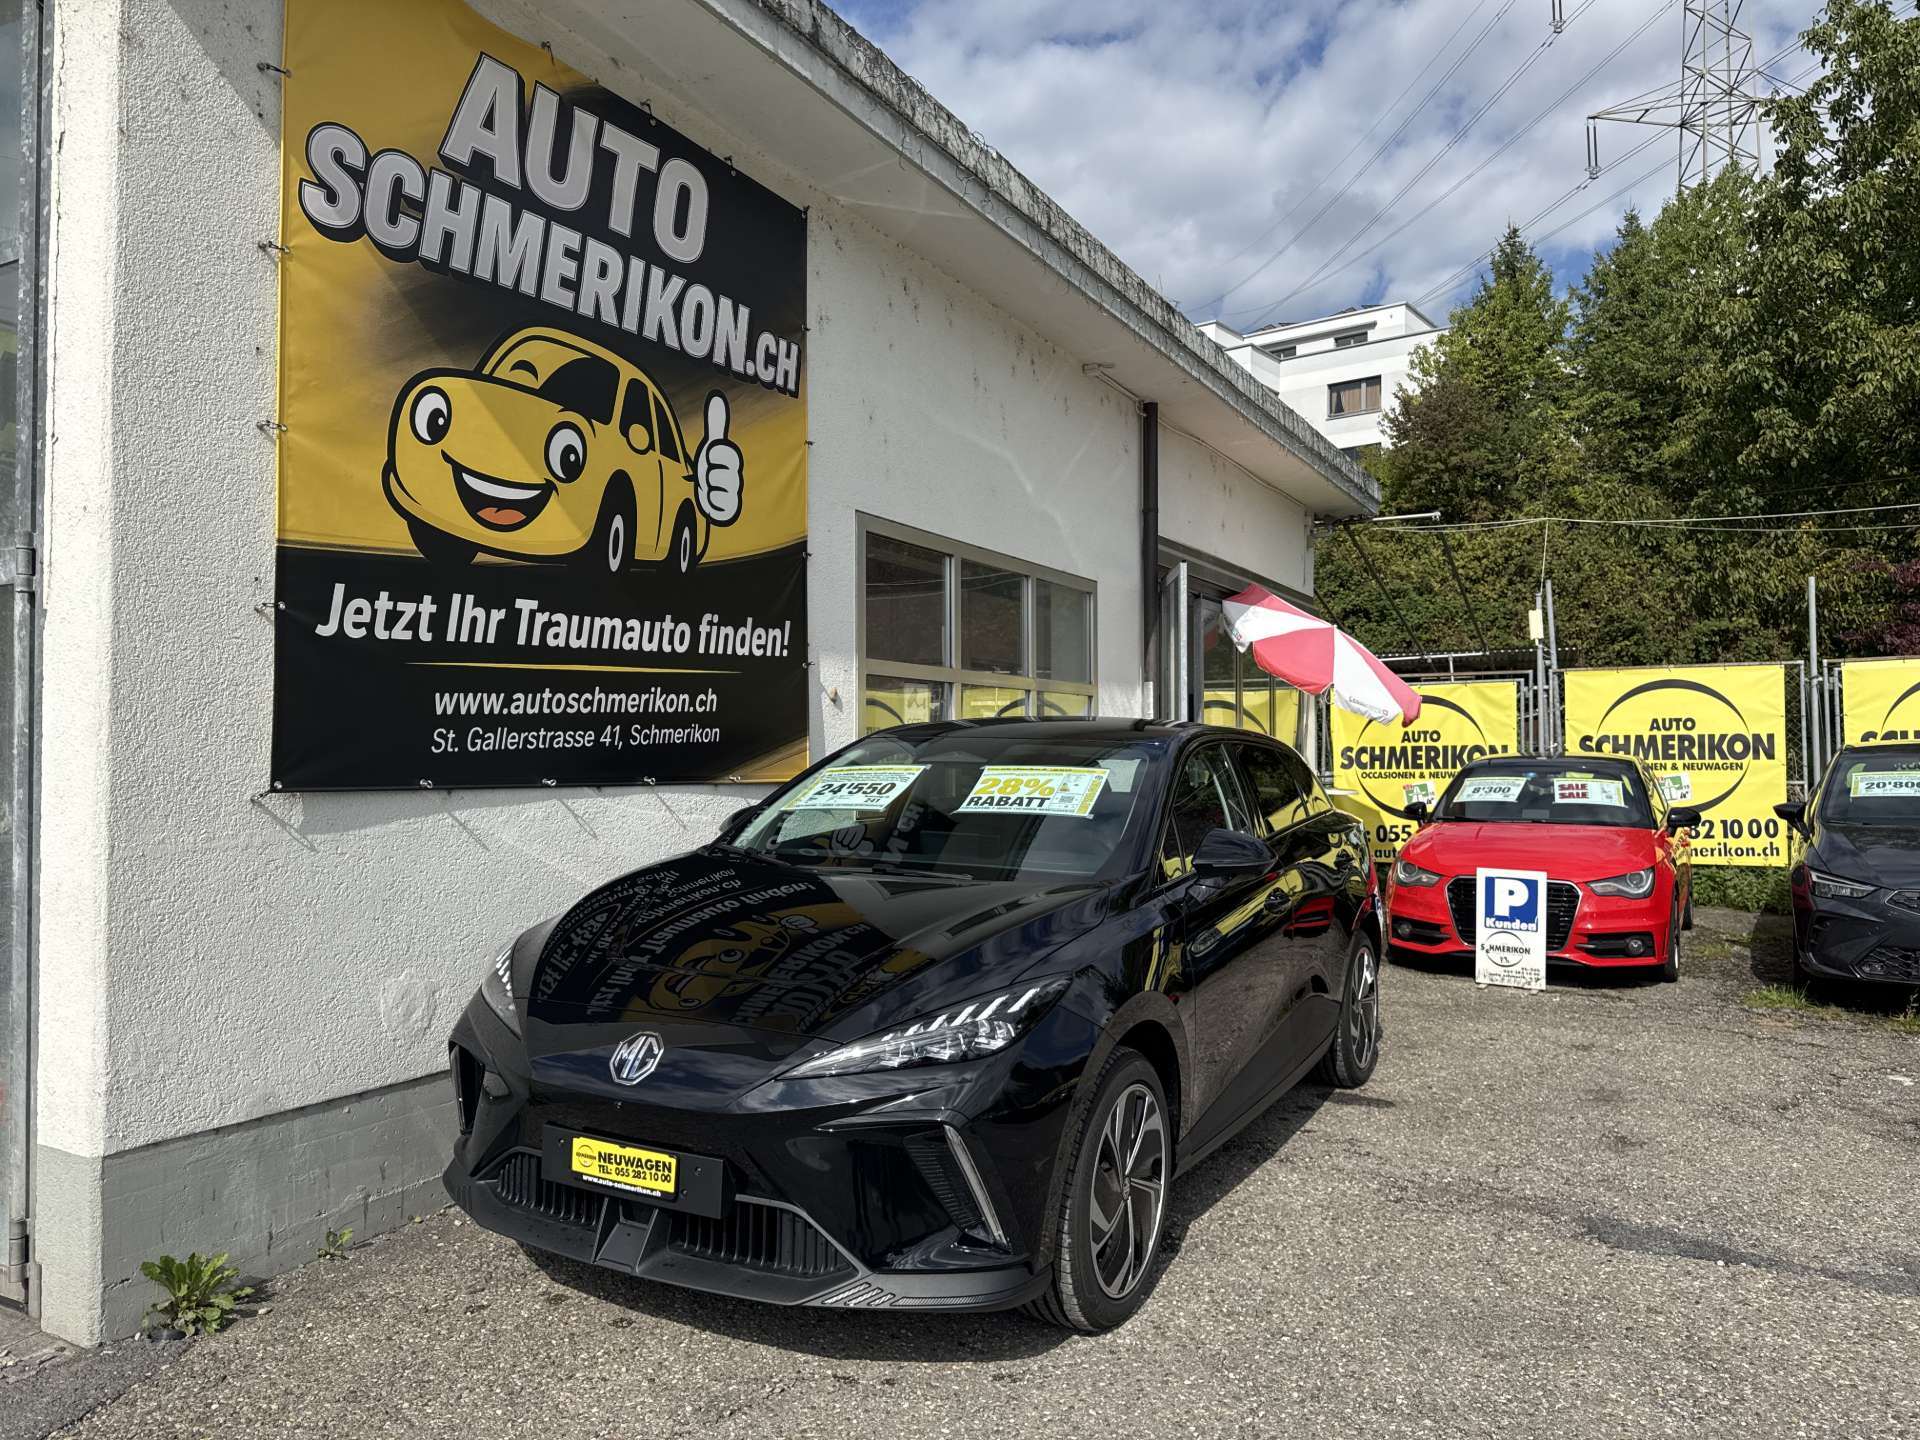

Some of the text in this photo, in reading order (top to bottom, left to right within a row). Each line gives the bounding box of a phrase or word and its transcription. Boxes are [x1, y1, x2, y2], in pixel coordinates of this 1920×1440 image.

[440, 52, 709, 265] AUTO
[300, 123, 800, 394] SCHMERIKON.CH
[314, 583, 791, 658] Jetzt Ihr Traumauto finden!
[433, 686, 718, 716] www.autoschmerikon.ch
[1648, 718, 1696, 731] AUTO
[431, 724, 720, 754] St. Gallerstrasse 41, Schmerikon
[1401, 730, 1441, 744] AUTO
[1361, 771, 1416, 779] OCCASIONEN
[1418, 771, 1426, 779] &
[1682, 762, 1744, 771] NEUWAGEN
[814, 782, 897, 796] 24'550
[974, 777, 1056, 797] 28%
[1472, 786, 1511, 794] 8'300
[1558, 783, 1588, 791] SALE
[1558, 791, 1589, 799] SALE
[965, 796, 1051, 808] RABATT
[1375, 825, 1412, 843] 055
[1720, 819, 1744, 839] 10
[1747, 818, 1779, 840] 00
[1494, 878, 1529, 917] P
[1485, 917, 1538, 931] Kunden
[614, 1034, 660, 1079] MG
[598, 1150, 672, 1174] NEUWAGEN
[598, 1164, 672, 1183] TEL: 055 282 10 00
